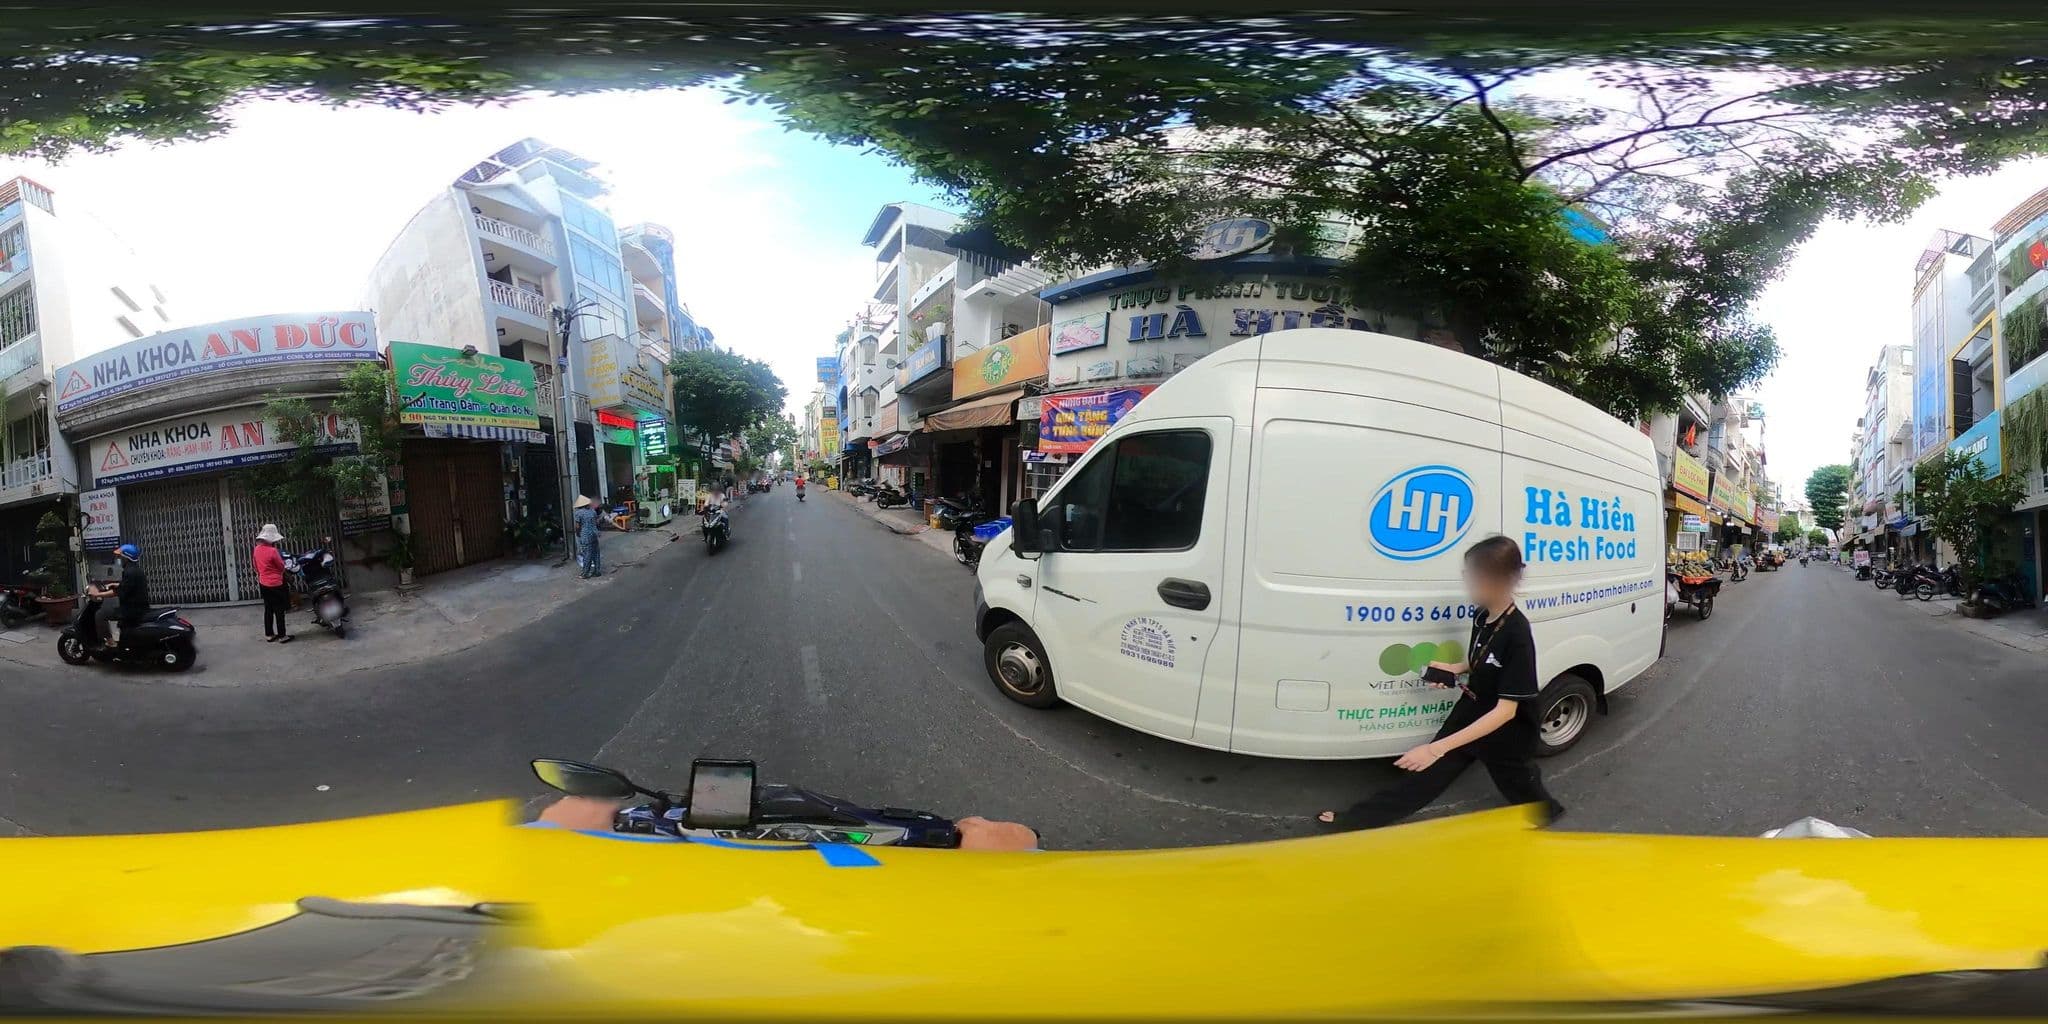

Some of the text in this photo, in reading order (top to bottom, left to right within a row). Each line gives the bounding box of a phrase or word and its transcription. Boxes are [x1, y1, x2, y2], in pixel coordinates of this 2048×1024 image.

[1127, 304, 1206, 342] HÀ
[93, 315, 367, 388] NHA KHOA AN ĐỨC
[407, 364, 472, 398] Thúy
[429, 397, 457, 412] Trang
[129, 431, 161, 452] NHA
[165, 421, 211, 445] KHOA
[220, 420, 264, 450] AN
[1525, 486, 1635, 532] Hà Hiền
[1525, 532, 1636, 562] Fresh Food
[1525, 579, 1654, 610] www.thucphamhahien.com
[1345, 604, 1475, 622] 1900 63 64 08
[1337, 700, 1454, 723] THỰC PHẨM NHẬP
[1359, 720, 1395, 732] HÀNG
